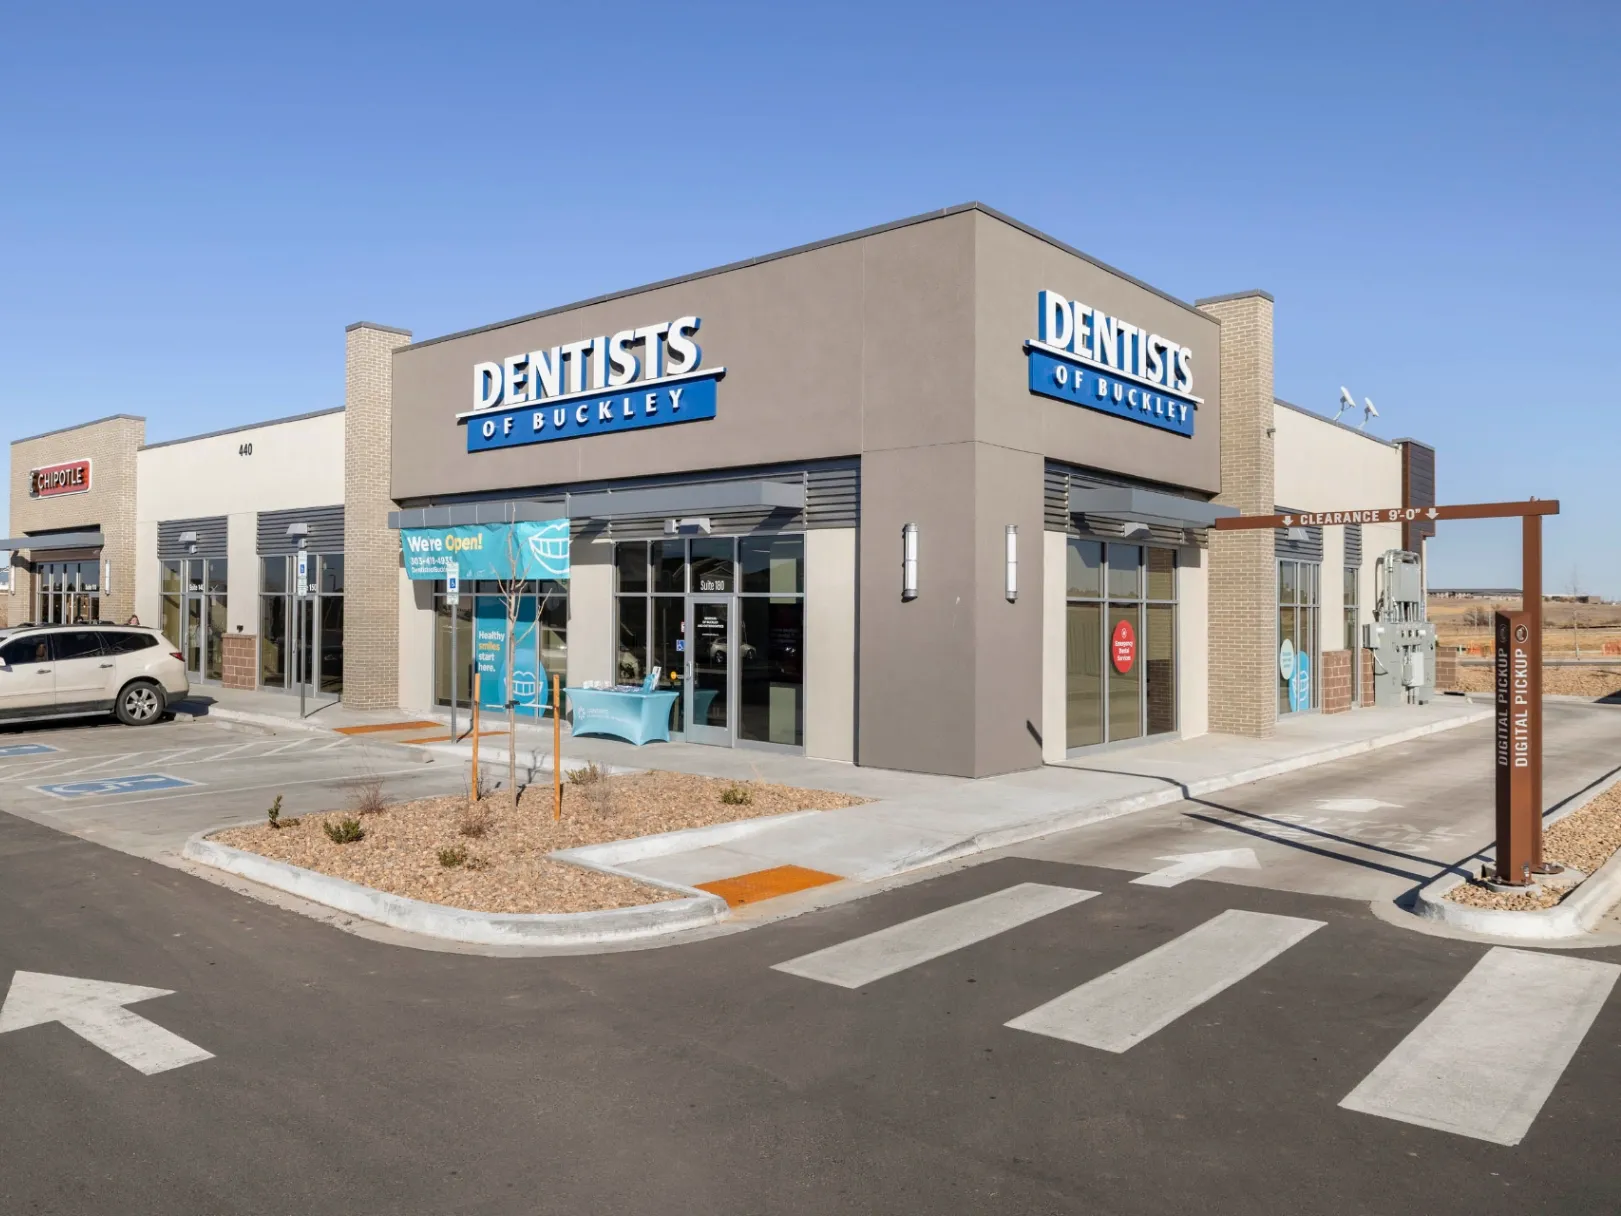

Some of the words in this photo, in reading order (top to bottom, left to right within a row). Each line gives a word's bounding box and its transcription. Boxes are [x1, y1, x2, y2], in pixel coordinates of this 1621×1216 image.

[1039, 290, 1193, 394] DENTISTS
[473, 316, 700, 411] DENTISTS
[1055, 365, 1083, 389] OF
[1098, 377, 1188, 421] BUCKLEY
[482, 417, 514, 438] OF
[533, 388, 683, 430] BUCKLEY
[239, 442, 252, 456] 440
[38, 467, 82, 489] CHIPOTLE
[1300, 510, 1380, 525] CLEARANCE
[445, 532, 483, 554] Open!
[701, 580, 714, 590] Suite
[715, 580, 724, 590] 180
[478, 631, 505, 642] Healthy
[479, 641, 500, 651] smiles
[478, 662, 496, 672] here.
[479, 653, 495, 661] start
[1498, 647, 1508, 704] PICKUP
[1514, 648, 1528, 705] PICKUP
[1498, 708, 1508, 766] DIGITAL
[1514, 709, 1528, 767] DIGITAL
